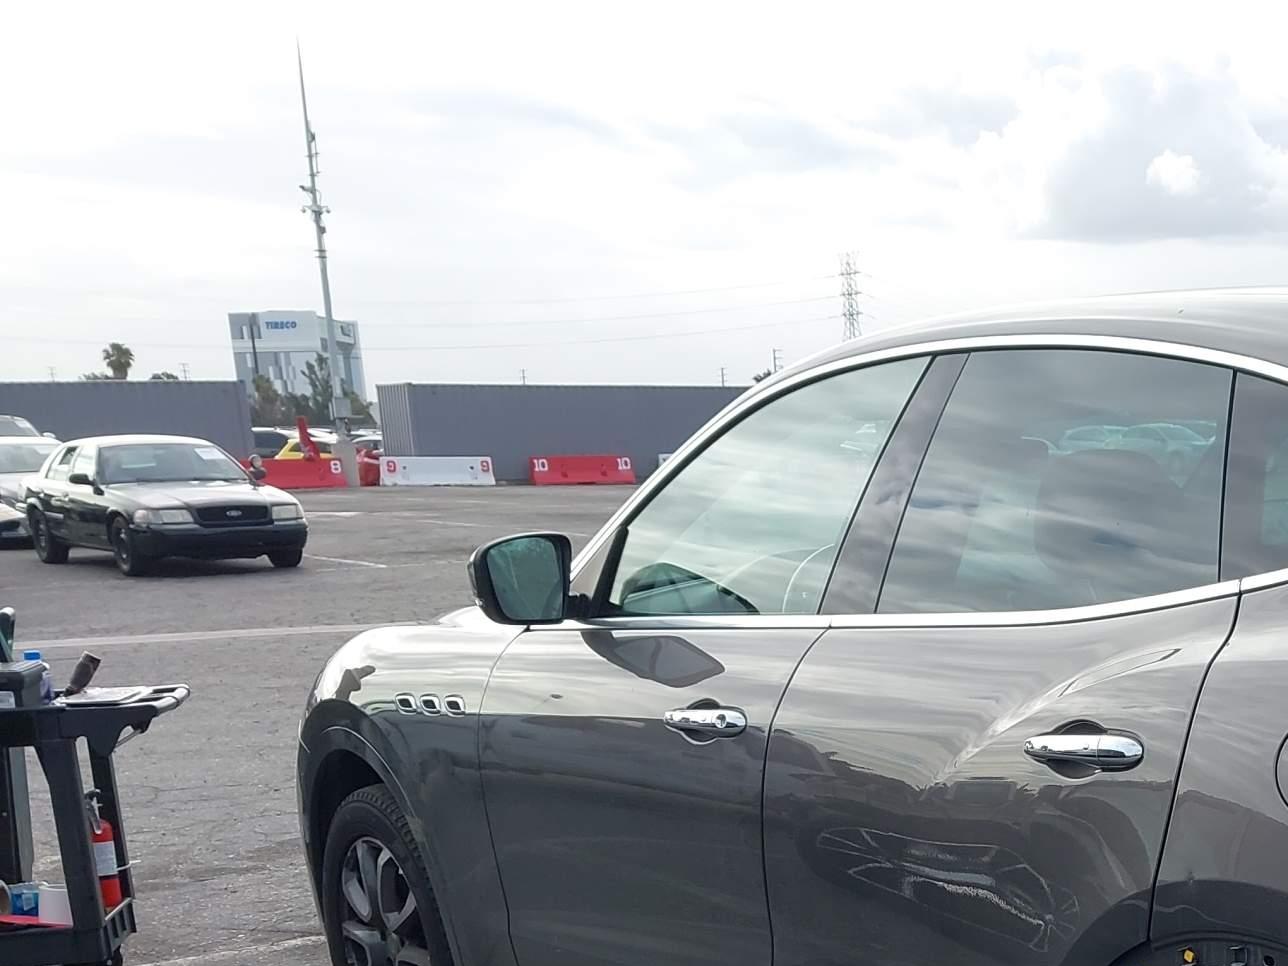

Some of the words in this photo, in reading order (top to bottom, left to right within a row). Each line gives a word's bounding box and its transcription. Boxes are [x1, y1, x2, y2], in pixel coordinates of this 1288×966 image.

[265, 321, 297, 329] TIRECO
[330, 460, 342, 473] 8
[386, 460, 396, 473] 9
[480, 460, 490, 472] 9
[533, 458, 548, 471] 10
[616, 457, 631, 470] 10
